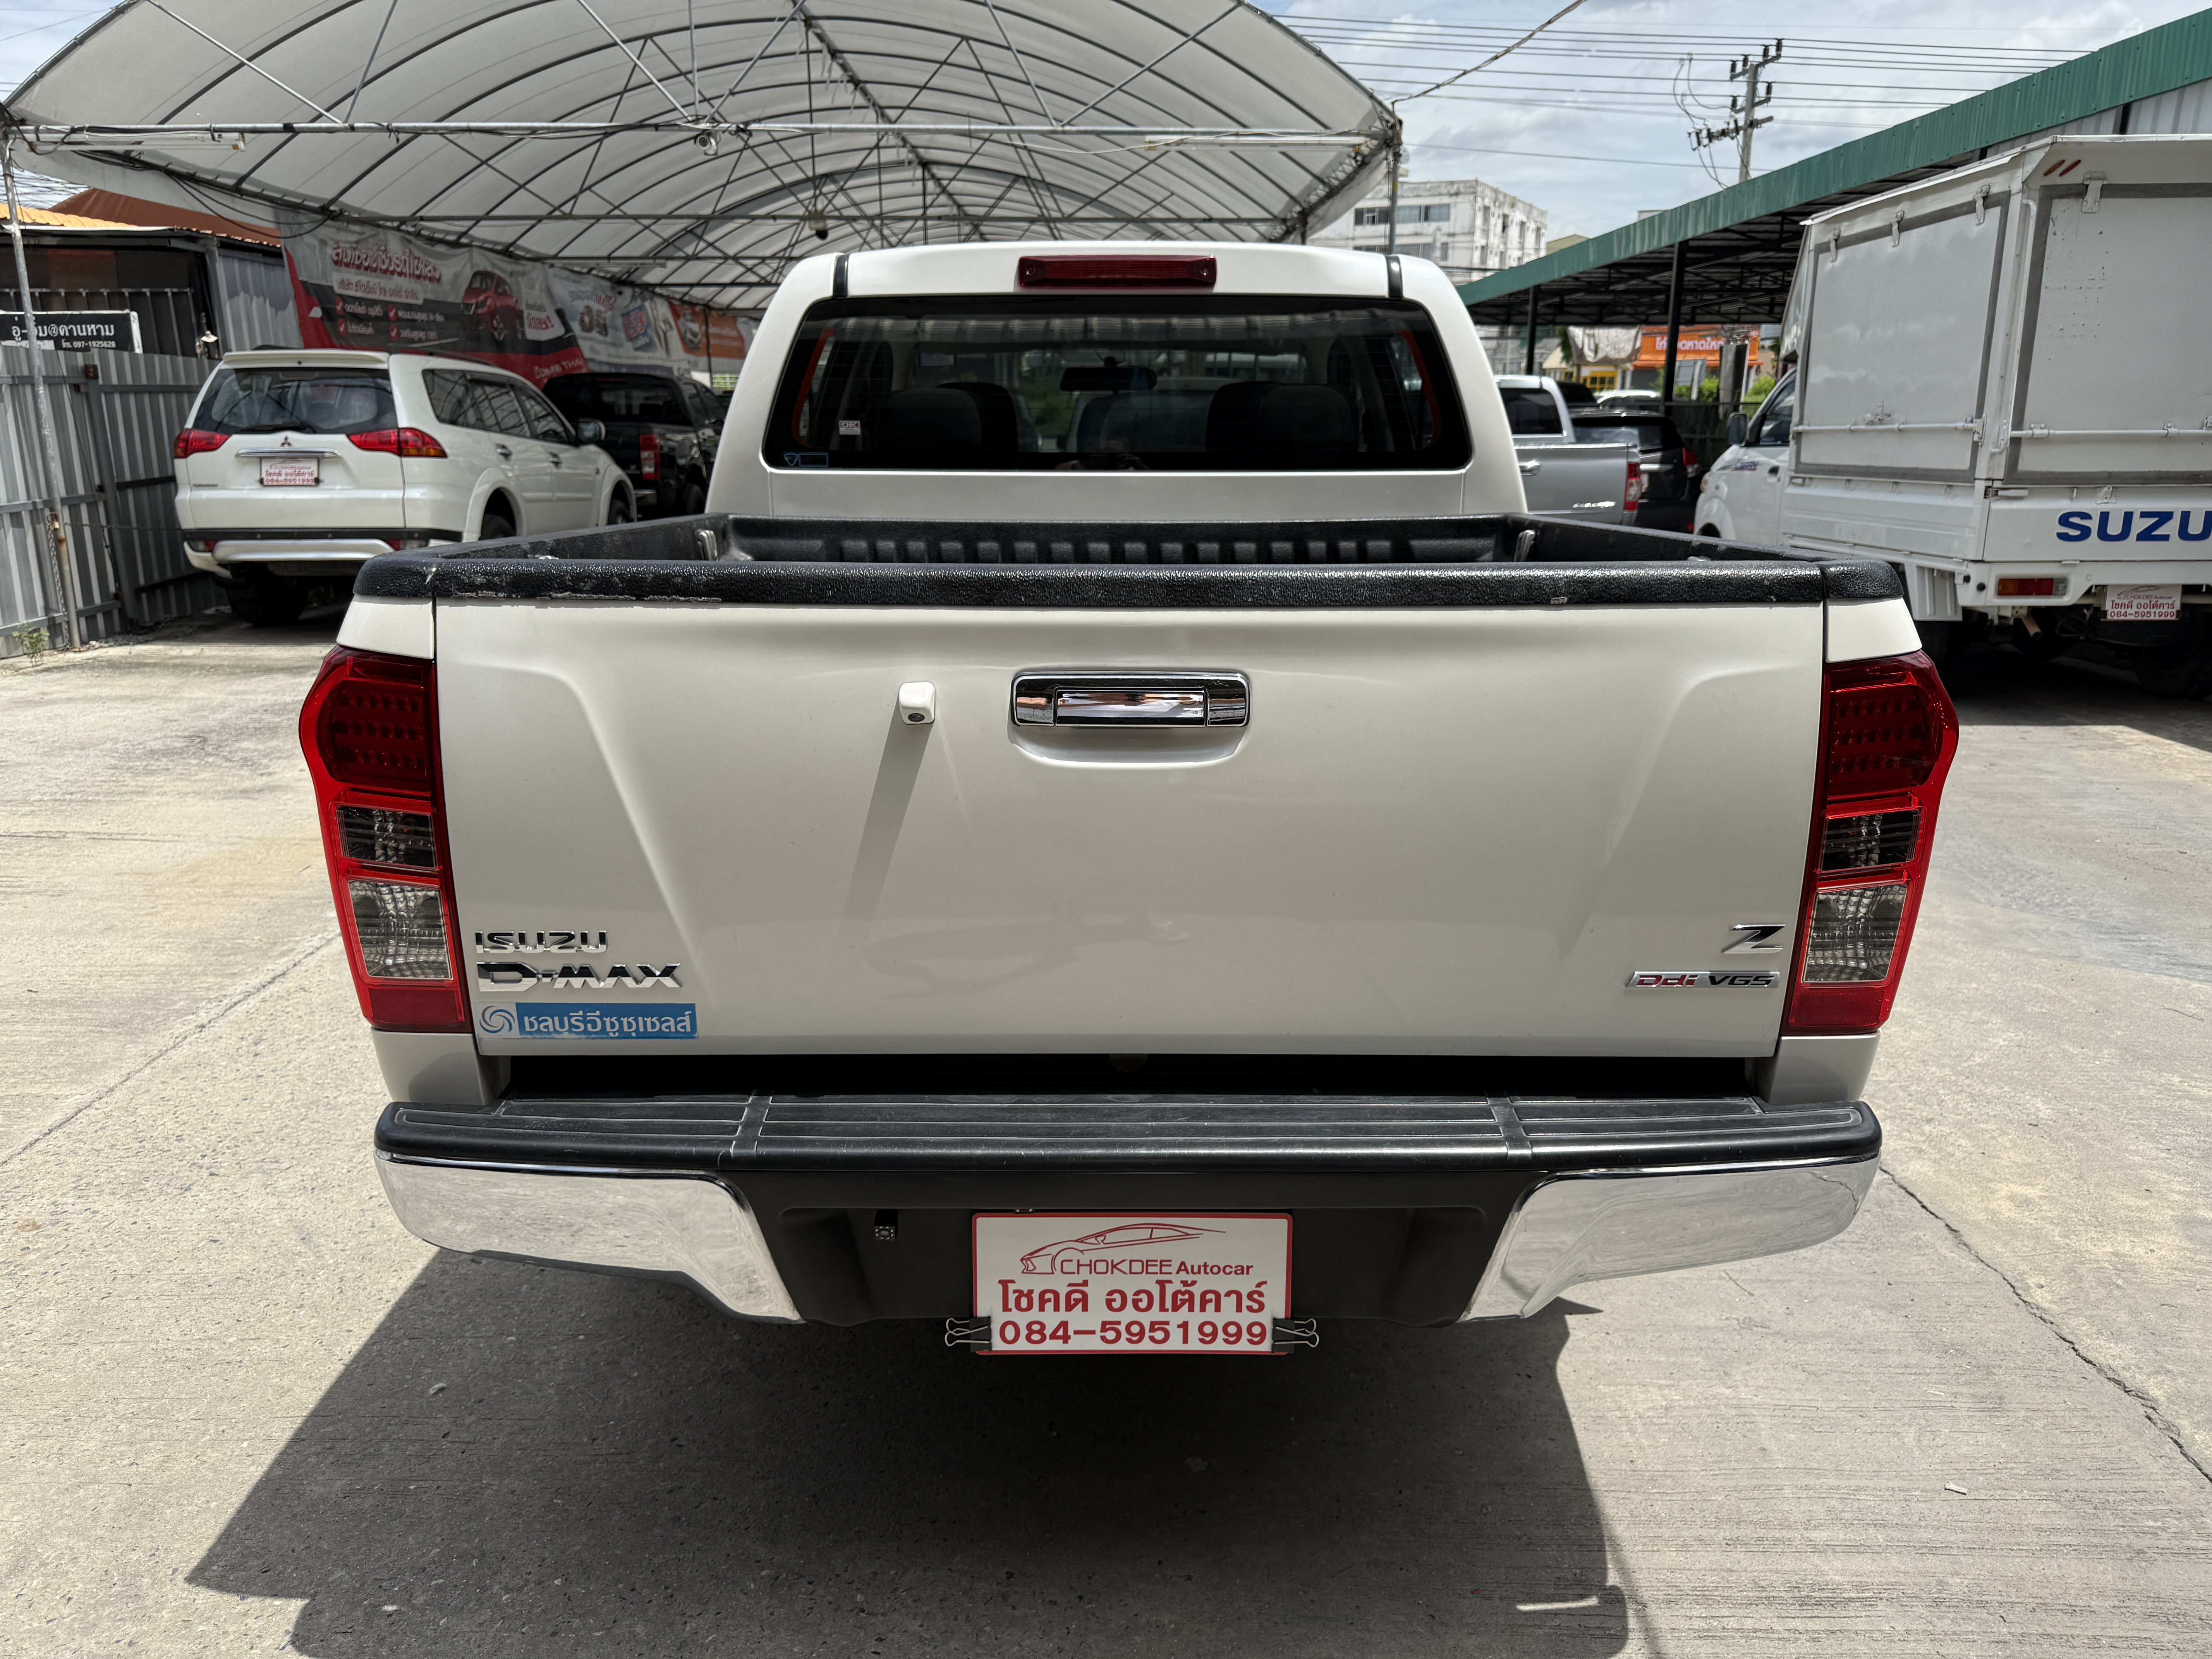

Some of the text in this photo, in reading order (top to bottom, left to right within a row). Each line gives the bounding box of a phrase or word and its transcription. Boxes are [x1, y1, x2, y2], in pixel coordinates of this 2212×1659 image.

[2111, 600, 2176, 610] โชคดี ออโต้คาร์
[475, 930, 607, 953] ISUZU
[1721, 924, 1786, 954] Z
[476, 961, 683, 992] D-MAX
[1635, 974, 1775, 988] Ddi VGS
[1060, 1259, 1254, 1275] CHOKDEE Autocar
[998, 1279, 1267, 1313] โชคดี ออโต้คาร์
[999, 1320, 1267, 1345] 084-5951999
